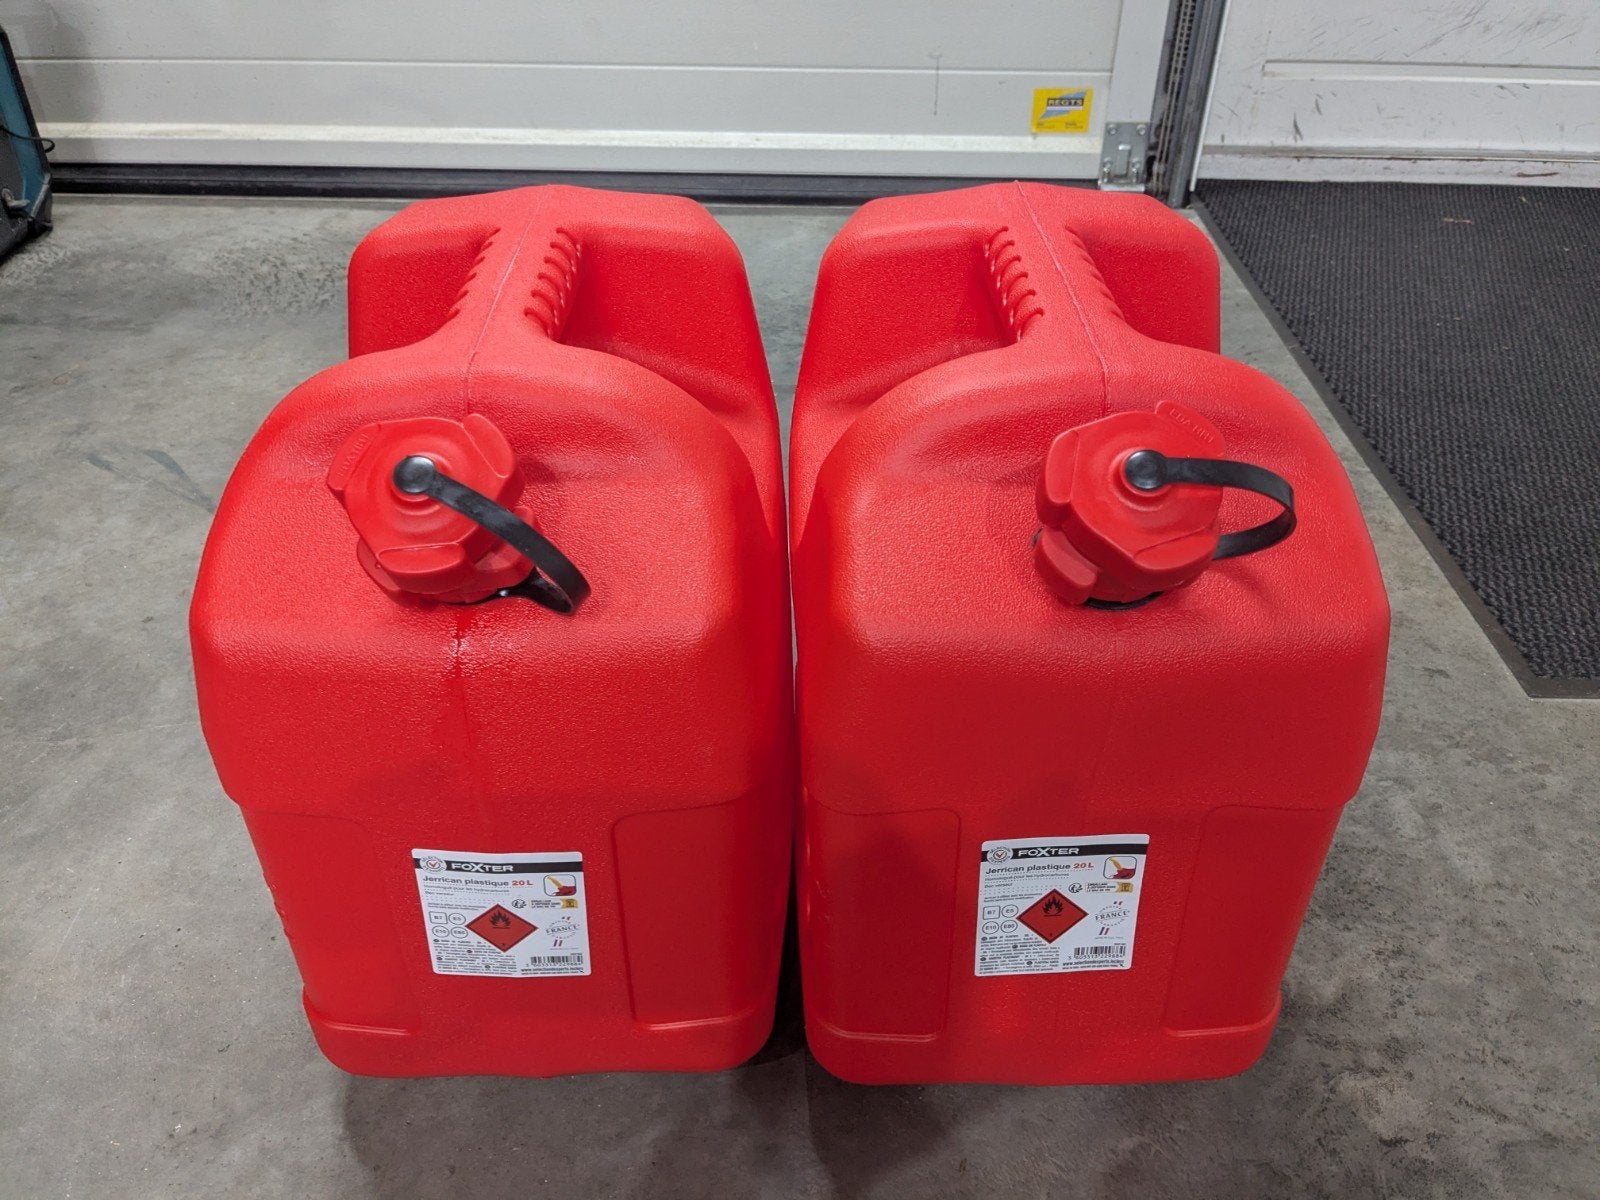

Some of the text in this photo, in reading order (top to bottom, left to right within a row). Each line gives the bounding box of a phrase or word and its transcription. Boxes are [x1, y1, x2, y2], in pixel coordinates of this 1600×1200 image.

[1018, 847, 1080, 857] FOXTER
[451, 862, 514, 873] FOXTER
[985, 865, 1025, 875] Jerrican
[1027, 862, 1071, 872] plastique
[423, 875, 463, 884] Jerrican
[465, 878, 509, 887] plastique
[1095, 910, 1127, 921] FRANCE
[545, 924, 578, 934] FRANCE
